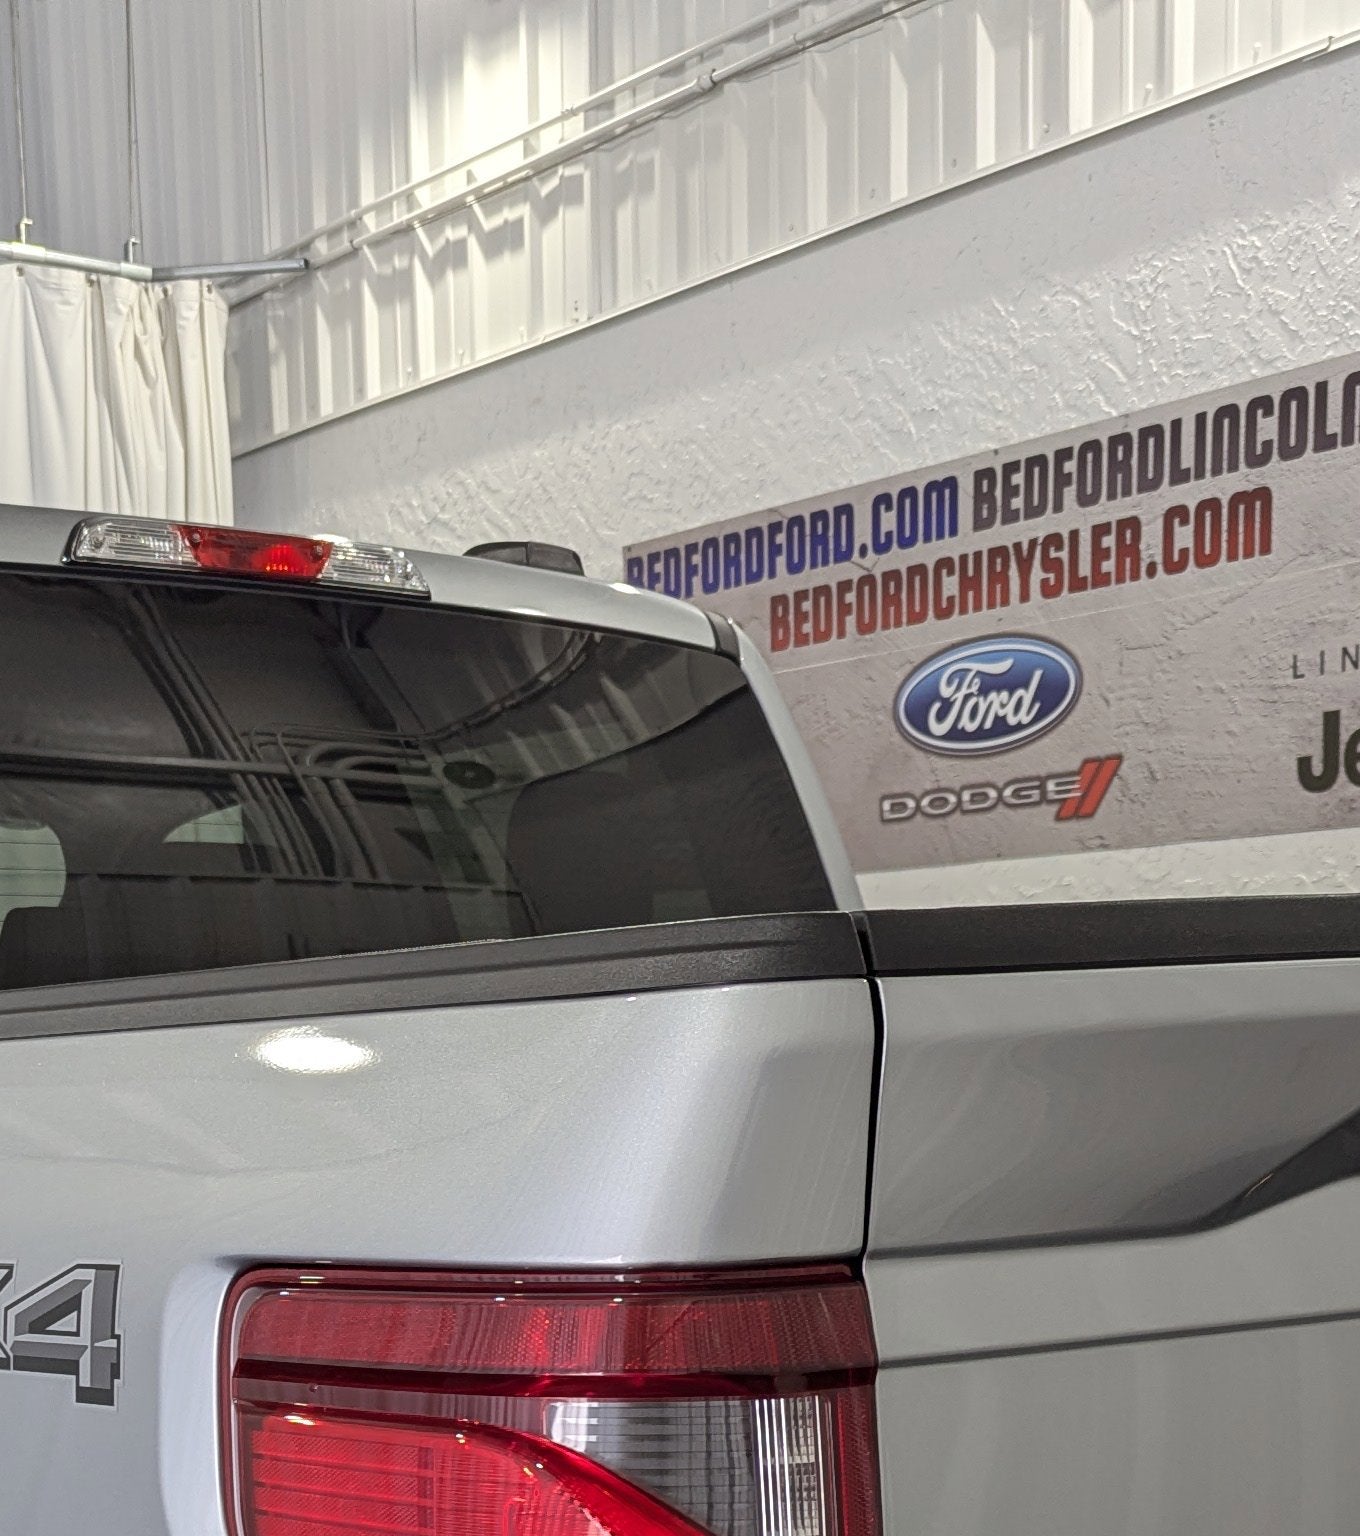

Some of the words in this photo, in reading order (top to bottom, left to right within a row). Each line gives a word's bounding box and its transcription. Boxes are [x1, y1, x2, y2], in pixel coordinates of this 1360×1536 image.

[627, 475, 959, 600] BEDFORDFORD.COM
[770, 485, 1273, 653] BEDFORDCHRYSLER.COM
[928, 657, 1044, 736] Ford
[880, 773, 1084, 823] DODGE
